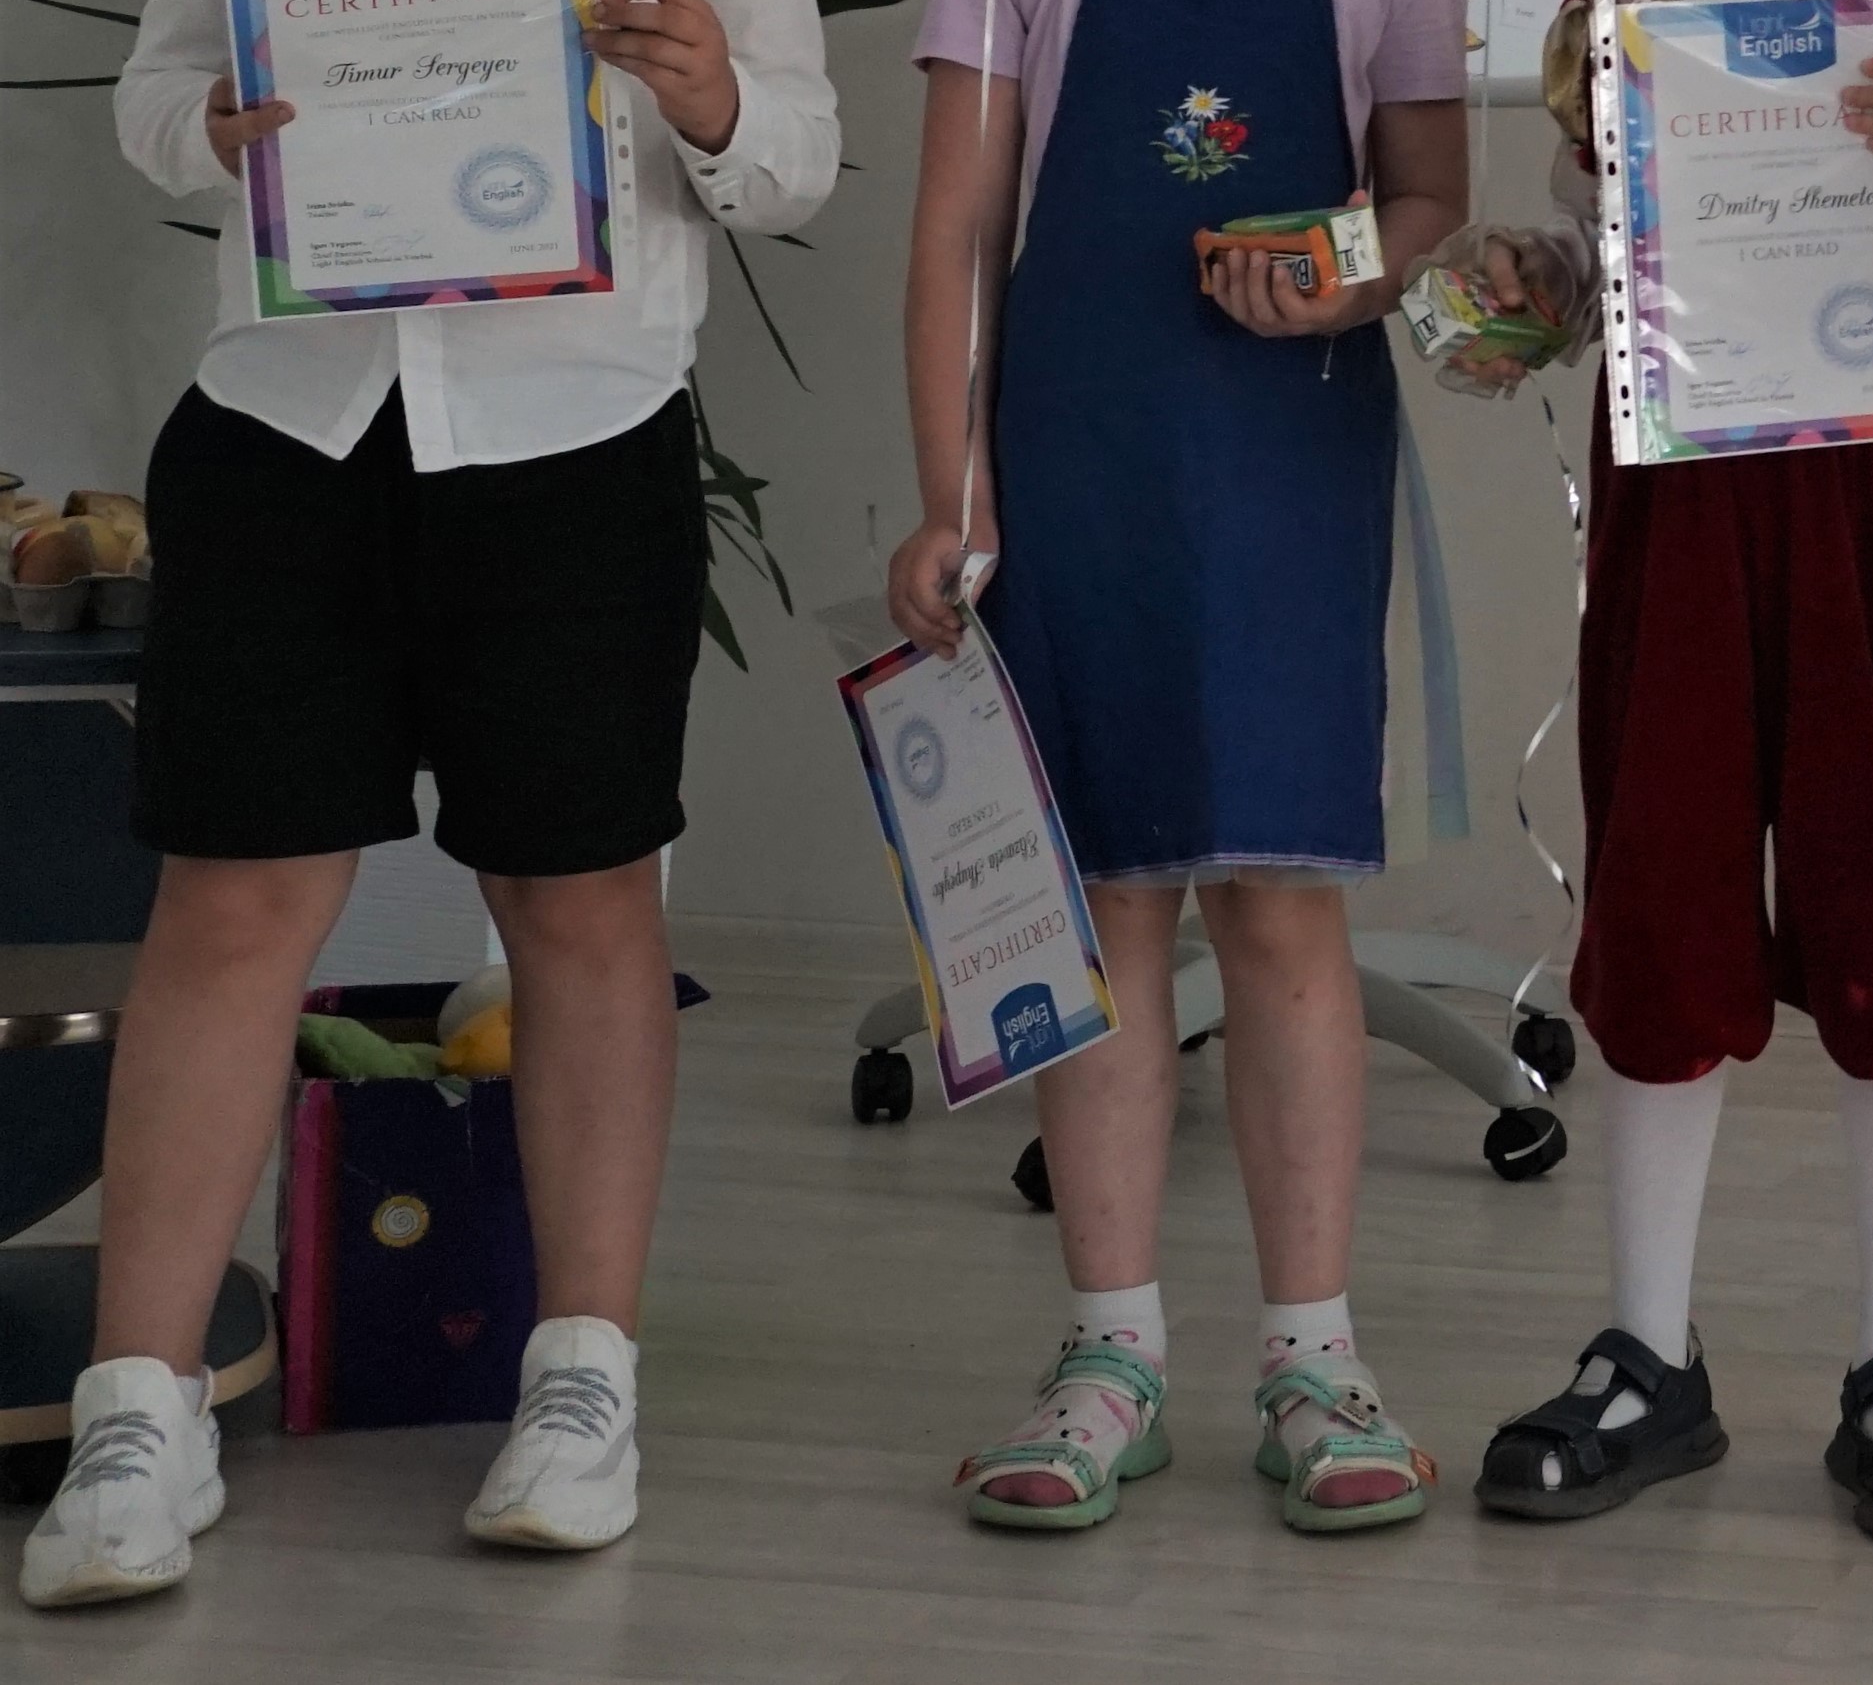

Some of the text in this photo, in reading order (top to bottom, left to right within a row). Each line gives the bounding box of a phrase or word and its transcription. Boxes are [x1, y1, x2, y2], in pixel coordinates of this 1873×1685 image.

[1739, 34, 1822, 60] English
[323, 53, 519, 90] Timur Sergeyev
[368, 106, 482, 127] I CAN READ
[1670, 104, 1851, 139] CERTIFICA
[1697, 192, 1780, 225] Dmitry
[1752, 243, 1791, 261] CAN
[1796, 241, 1839, 258] READ
[947, 911, 1067, 987] CERTIFICATE
[1002, 1001, 1051, 1036] English
